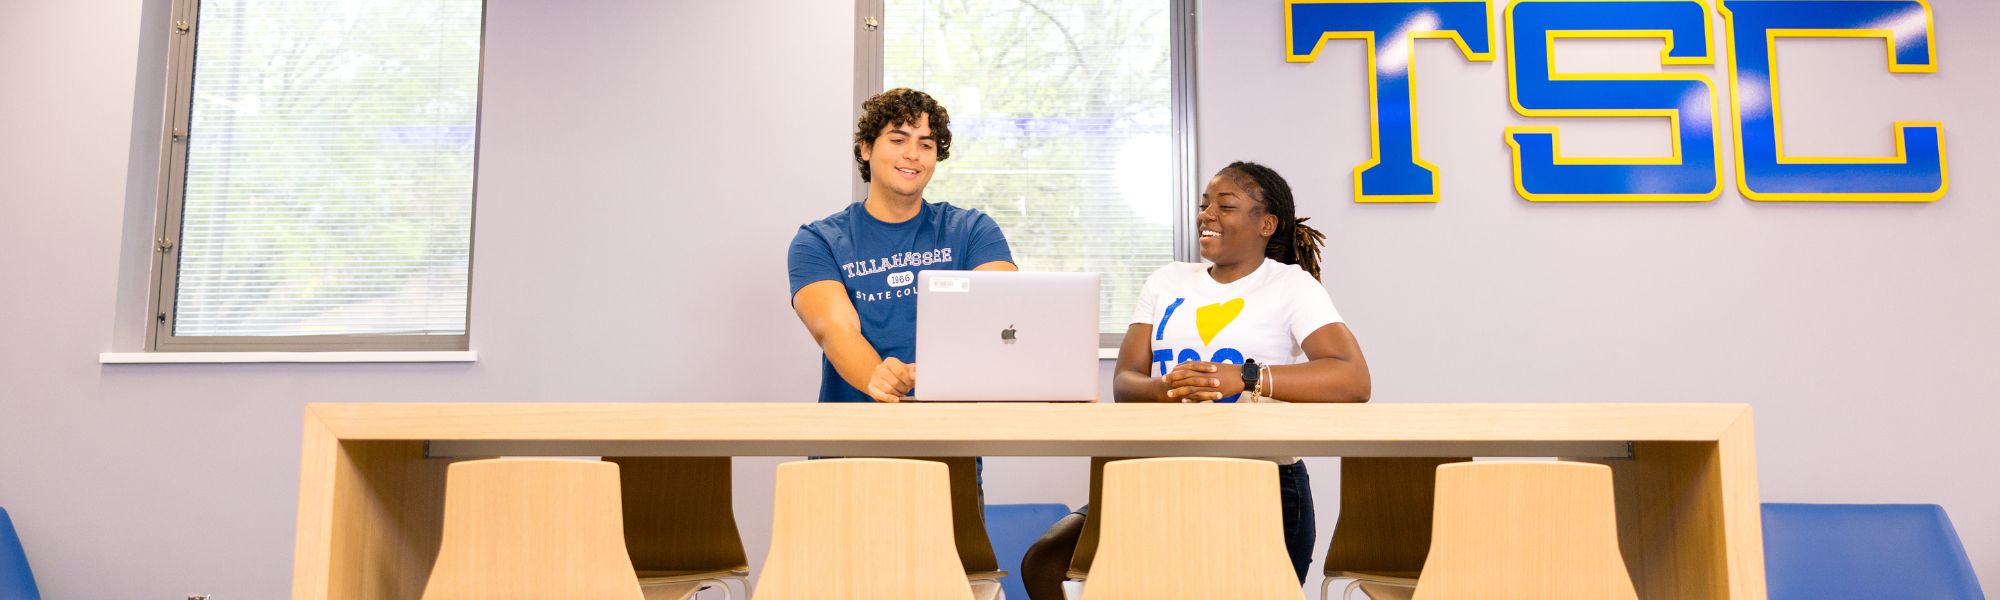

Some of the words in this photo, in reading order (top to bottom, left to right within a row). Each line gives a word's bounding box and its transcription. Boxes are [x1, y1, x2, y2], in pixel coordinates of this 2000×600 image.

[1286, 0, 1948, 203] TSC
[856, 291, 892, 302] STATE
[896, 286, 918, 298] COL
[891, 274, 911, 285] 1966
[1156, 297, 1185, 341] I
